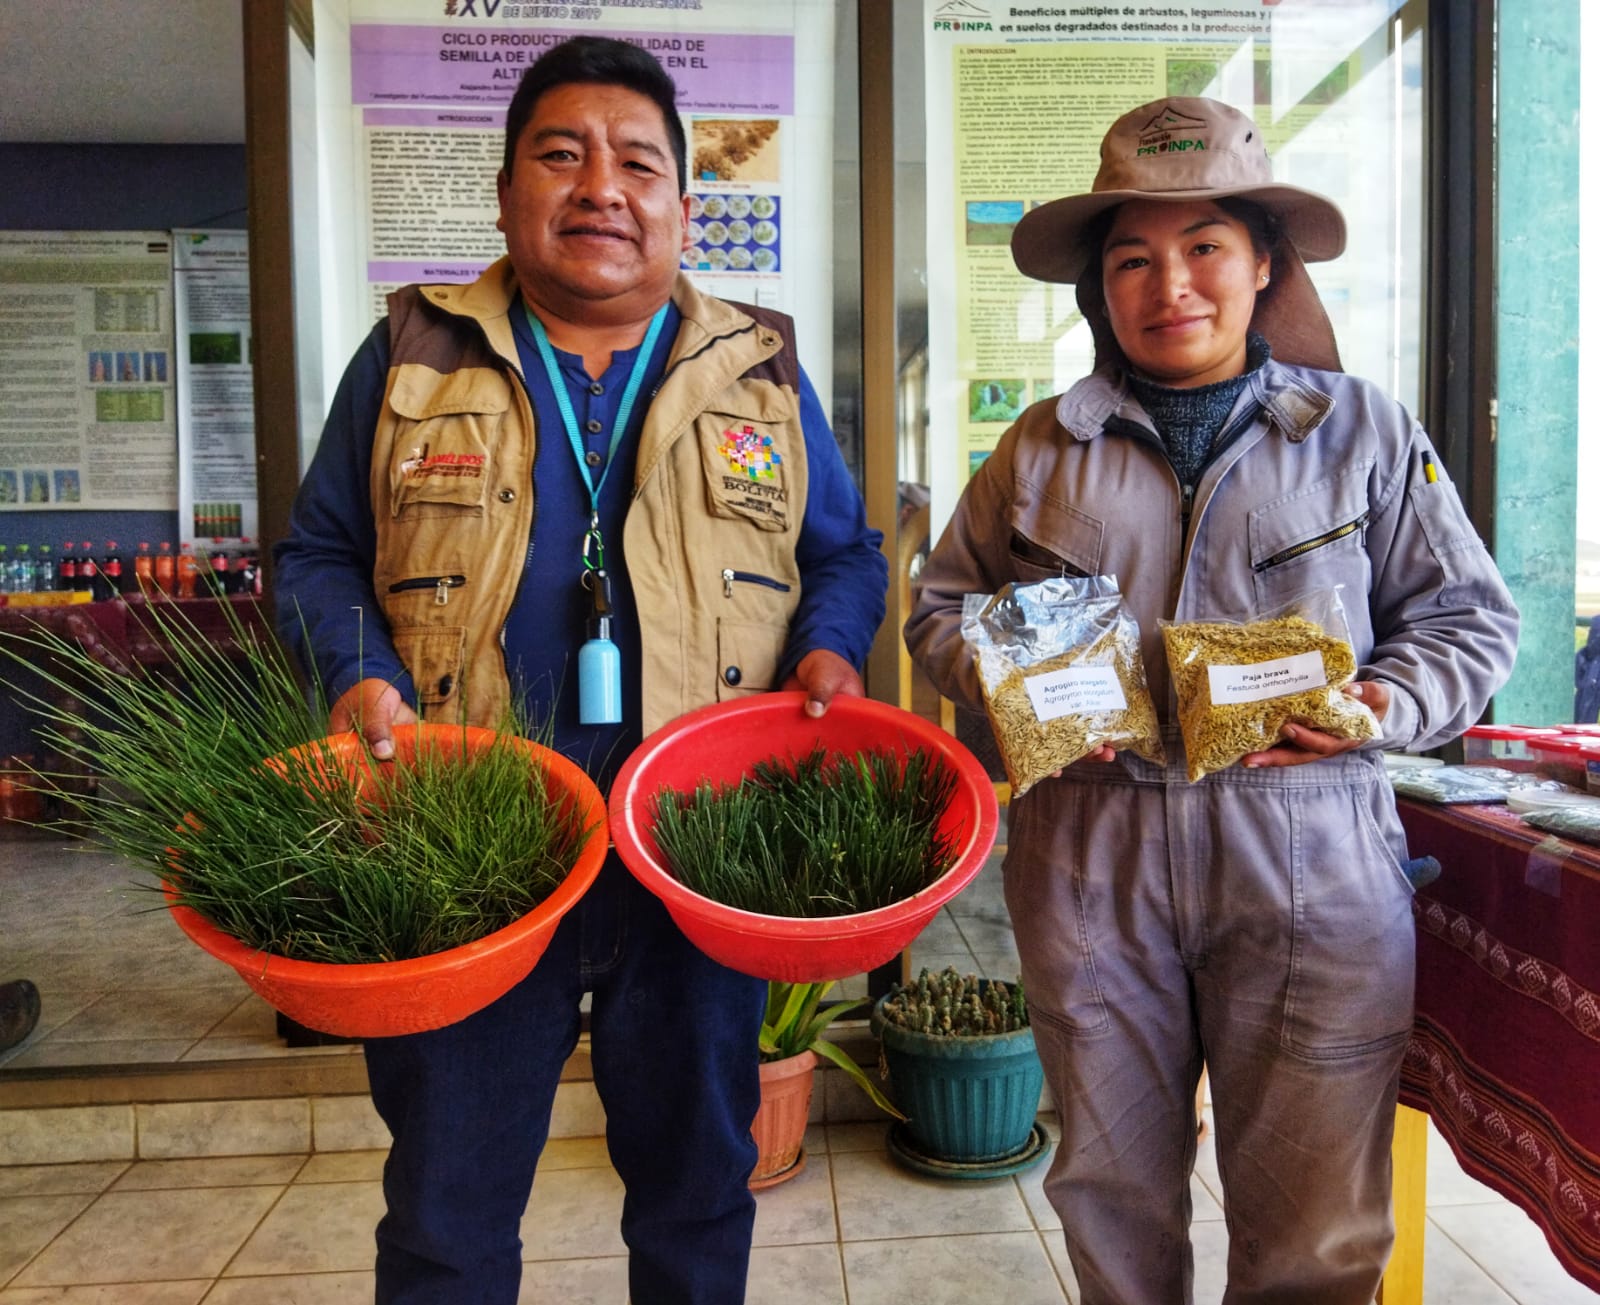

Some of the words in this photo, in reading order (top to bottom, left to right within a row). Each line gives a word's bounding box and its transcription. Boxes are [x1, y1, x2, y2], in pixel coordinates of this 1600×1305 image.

[522, 6, 569, 19] LUPINO
[1009, 7, 1066, 17] Beneficios
[1070, 6, 1119, 19] múltiples
[1122, 7, 1135, 16] de
[1138, 8, 1188, 18] arbustos,
[1191, 9, 1257, 20] leguminosas
[1259, 12, 1265, 20] y
[1016, 23, 1051, 32] suelos
[1054, 23, 1118, 33] degradados
[1121, 21, 1178, 32] destinados
[1191, 22, 1201, 32] la
[1204, 23, 1262, 34] producción
[442, 33, 487, 46] CICLO
[686, 40, 705, 52] DE
[440, 51, 502, 63] SEMILLA
[506, 51, 525, 63] DE
[667, 56, 686, 68] EN
[691, 57, 708, 69] EL
[1242, 674, 1262, 682] Paja
[1264, 669, 1290, 679] brava
[1226, 683, 1261, 692] Festuca
